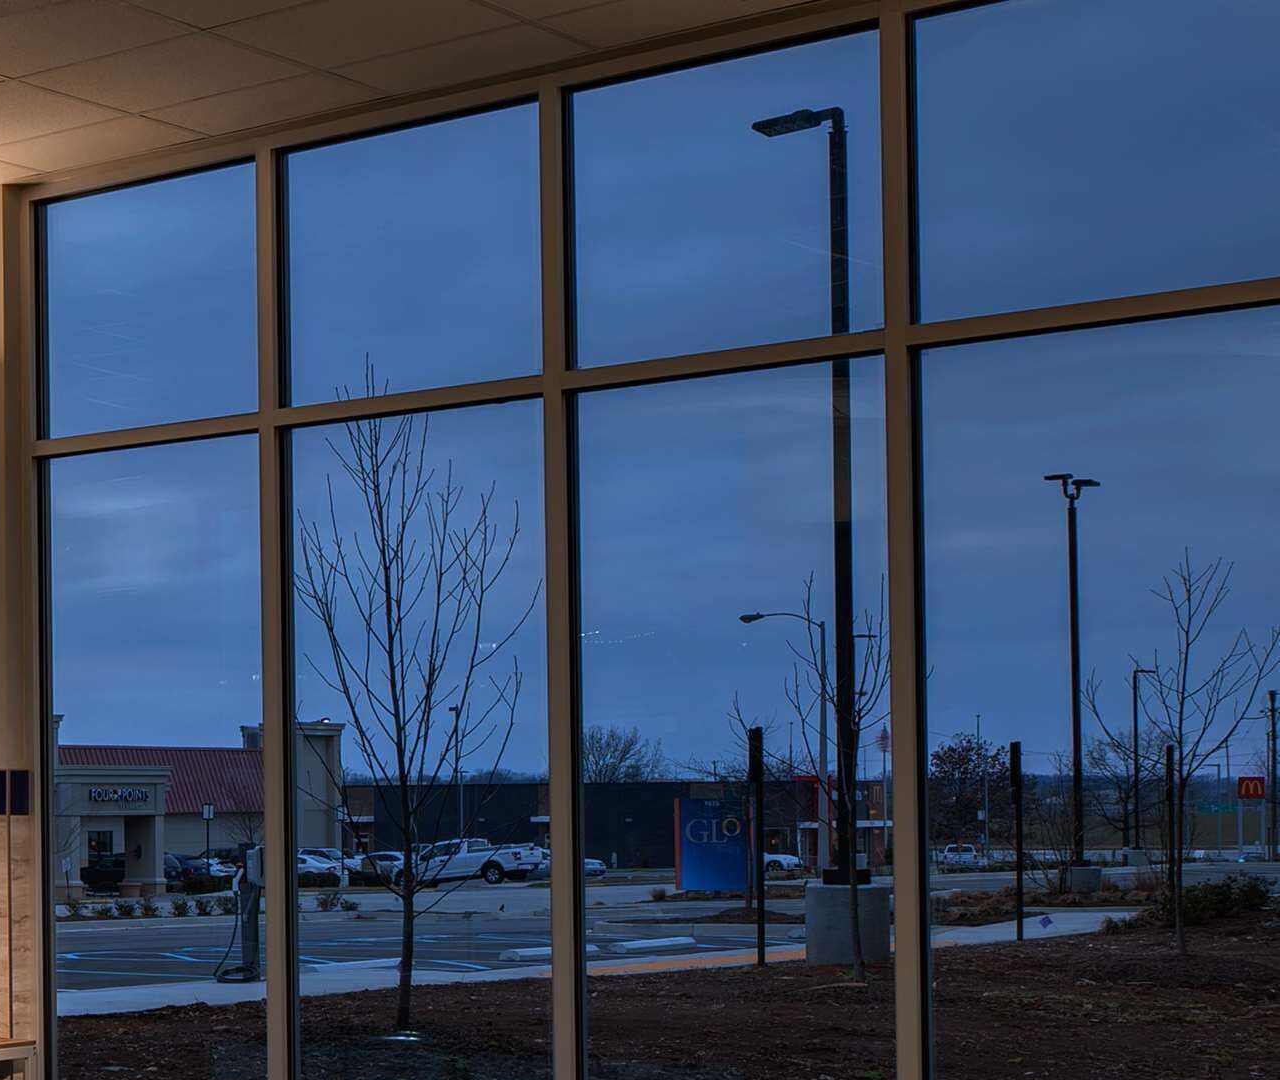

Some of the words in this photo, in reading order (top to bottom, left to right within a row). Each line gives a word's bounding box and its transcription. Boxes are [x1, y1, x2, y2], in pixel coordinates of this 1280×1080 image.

[89, 788, 114, 801] FOUR
[120, 788, 150, 801] POINTS
[685, 816, 741, 844] GLO
